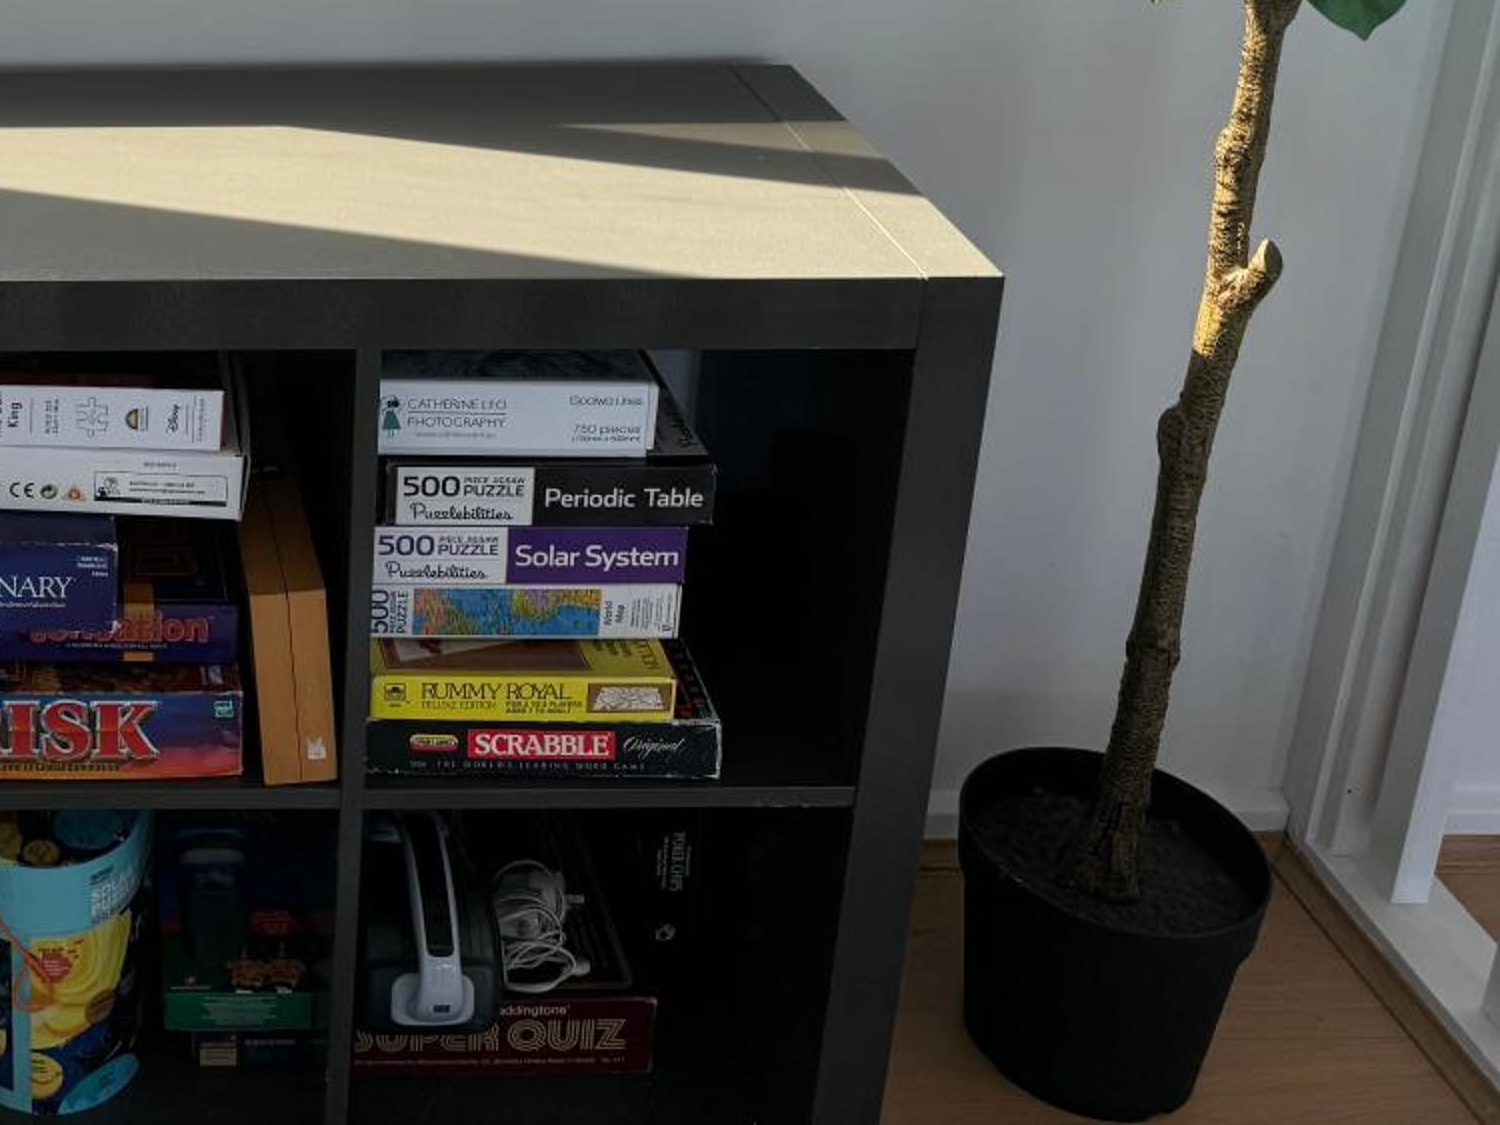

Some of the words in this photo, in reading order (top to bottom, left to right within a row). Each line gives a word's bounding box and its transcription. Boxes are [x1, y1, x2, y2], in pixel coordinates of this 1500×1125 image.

[6, 401, 23, 429] King
[407, 398, 479, 411] CATHERINE
[407, 416, 506, 429] PHOTOGRAPHY
[402, 475, 460, 497] 500
[463, 484, 525, 498] PUZZLE
[544, 486, 636, 510] Periodic
[643, 487, 704, 508] Table
[378, 534, 435, 557] 500
[437, 544, 500, 557] PUZZLE
[515, 544, 581, 567] Solar
[584, 544, 680, 572] System
[370, 589, 389, 635] 500
[421, 682, 503, 700] RUMMY
[505, 682, 574, 700] ROYAL
[473, 733, 610, 757] SCRABBLE
[621, 734, 684, 761] Original
[506, 1017, 627, 1052] QUIZ
